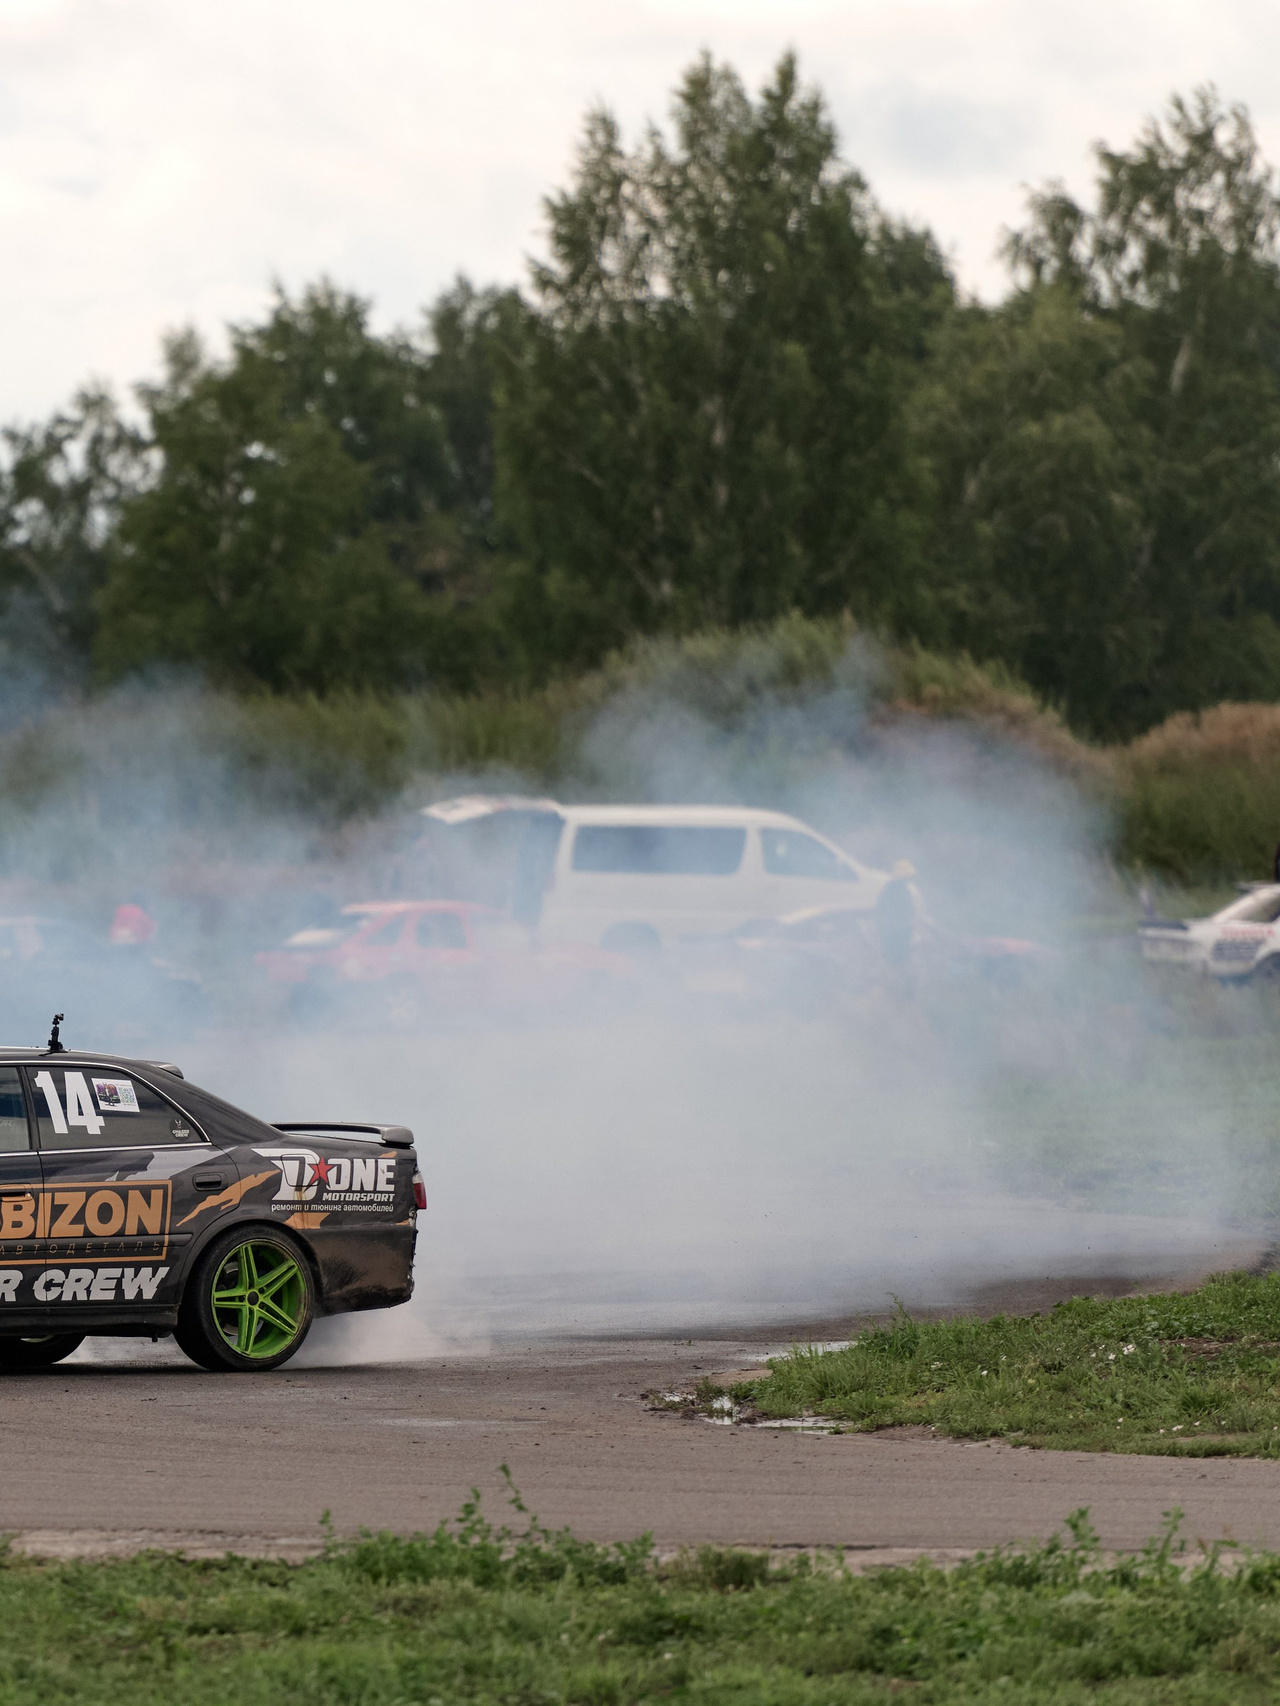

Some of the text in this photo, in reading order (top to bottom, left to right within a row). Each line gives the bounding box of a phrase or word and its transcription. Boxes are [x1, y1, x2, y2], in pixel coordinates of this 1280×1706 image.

[34, 1071, 105, 1135] 14
[271, 1204, 302, 1212] ремонт
[343, 1203, 394, 1212] автомобилей
[322, 1192, 395, 1202] MOTORSPORT
[31, 1266, 170, 1302] CREW
